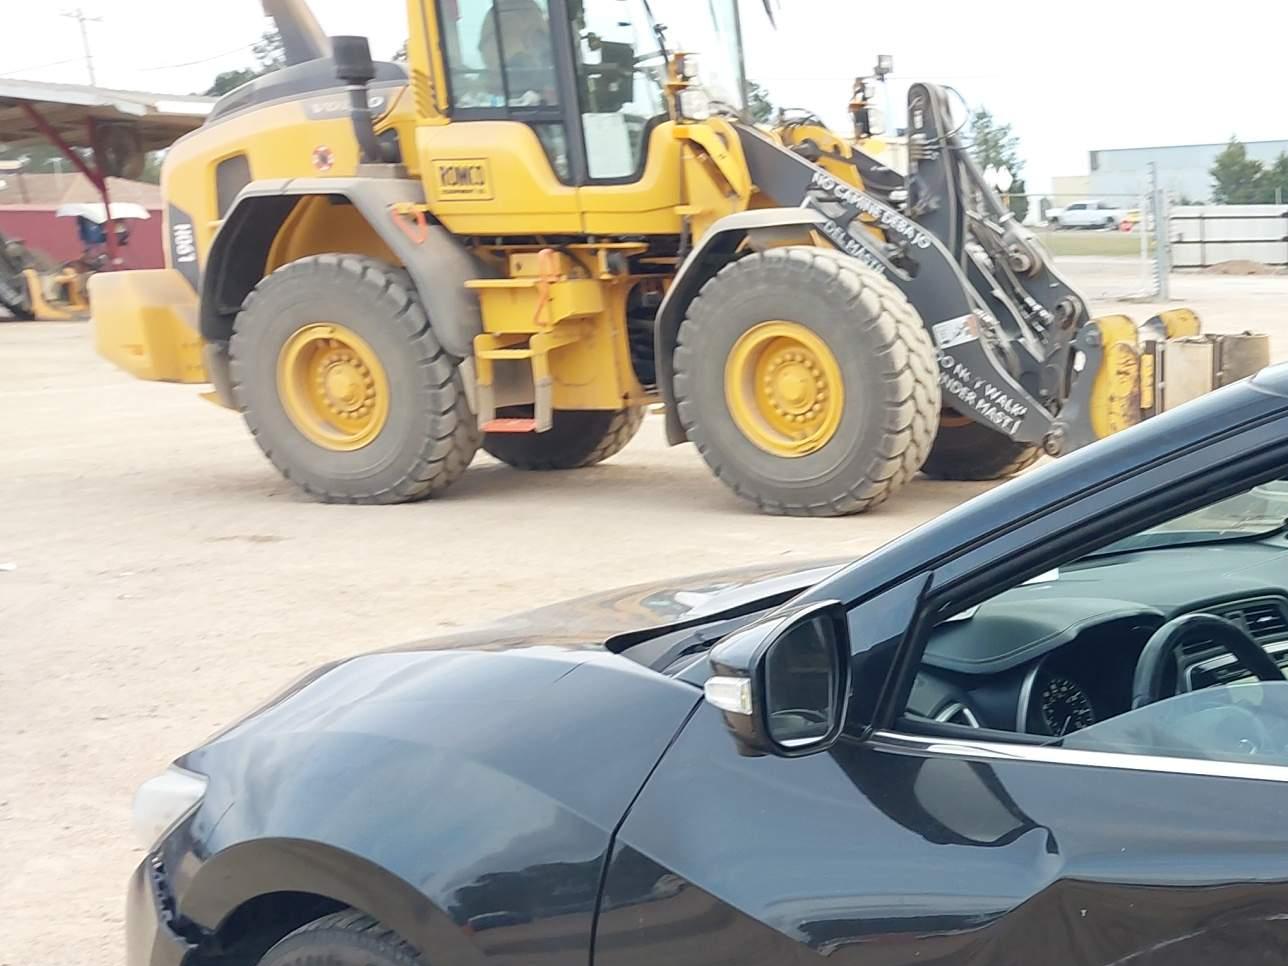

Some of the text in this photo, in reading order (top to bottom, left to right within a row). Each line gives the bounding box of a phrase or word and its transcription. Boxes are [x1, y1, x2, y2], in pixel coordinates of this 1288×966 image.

[811, 172, 835, 191] NO
[881, 210, 931, 249] DEBAJO
[823, 220, 849, 251] DEL
